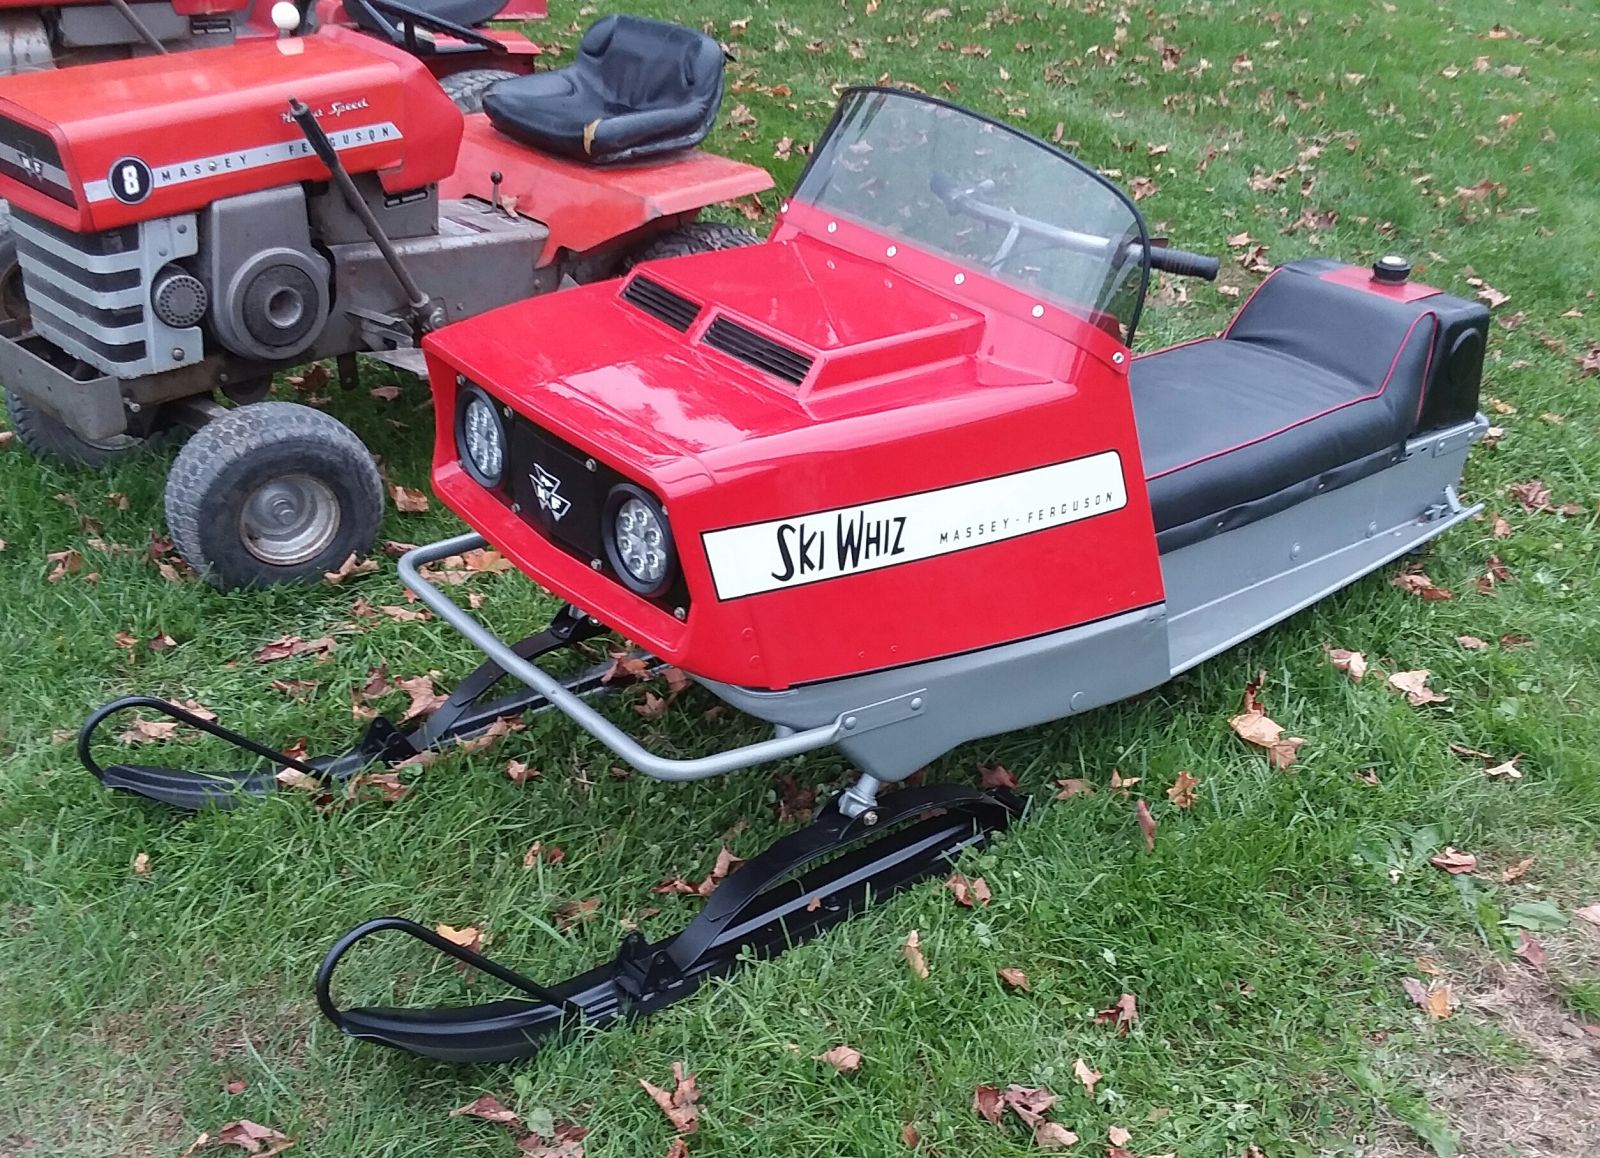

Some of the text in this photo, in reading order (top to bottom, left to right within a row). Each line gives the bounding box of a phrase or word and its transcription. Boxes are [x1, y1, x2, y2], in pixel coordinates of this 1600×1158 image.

[328, 98, 368, 117] Speed
[122, 127, 390, 196] 8 MASEY FEGUSON
[836, 510, 907, 571] WHIZ
